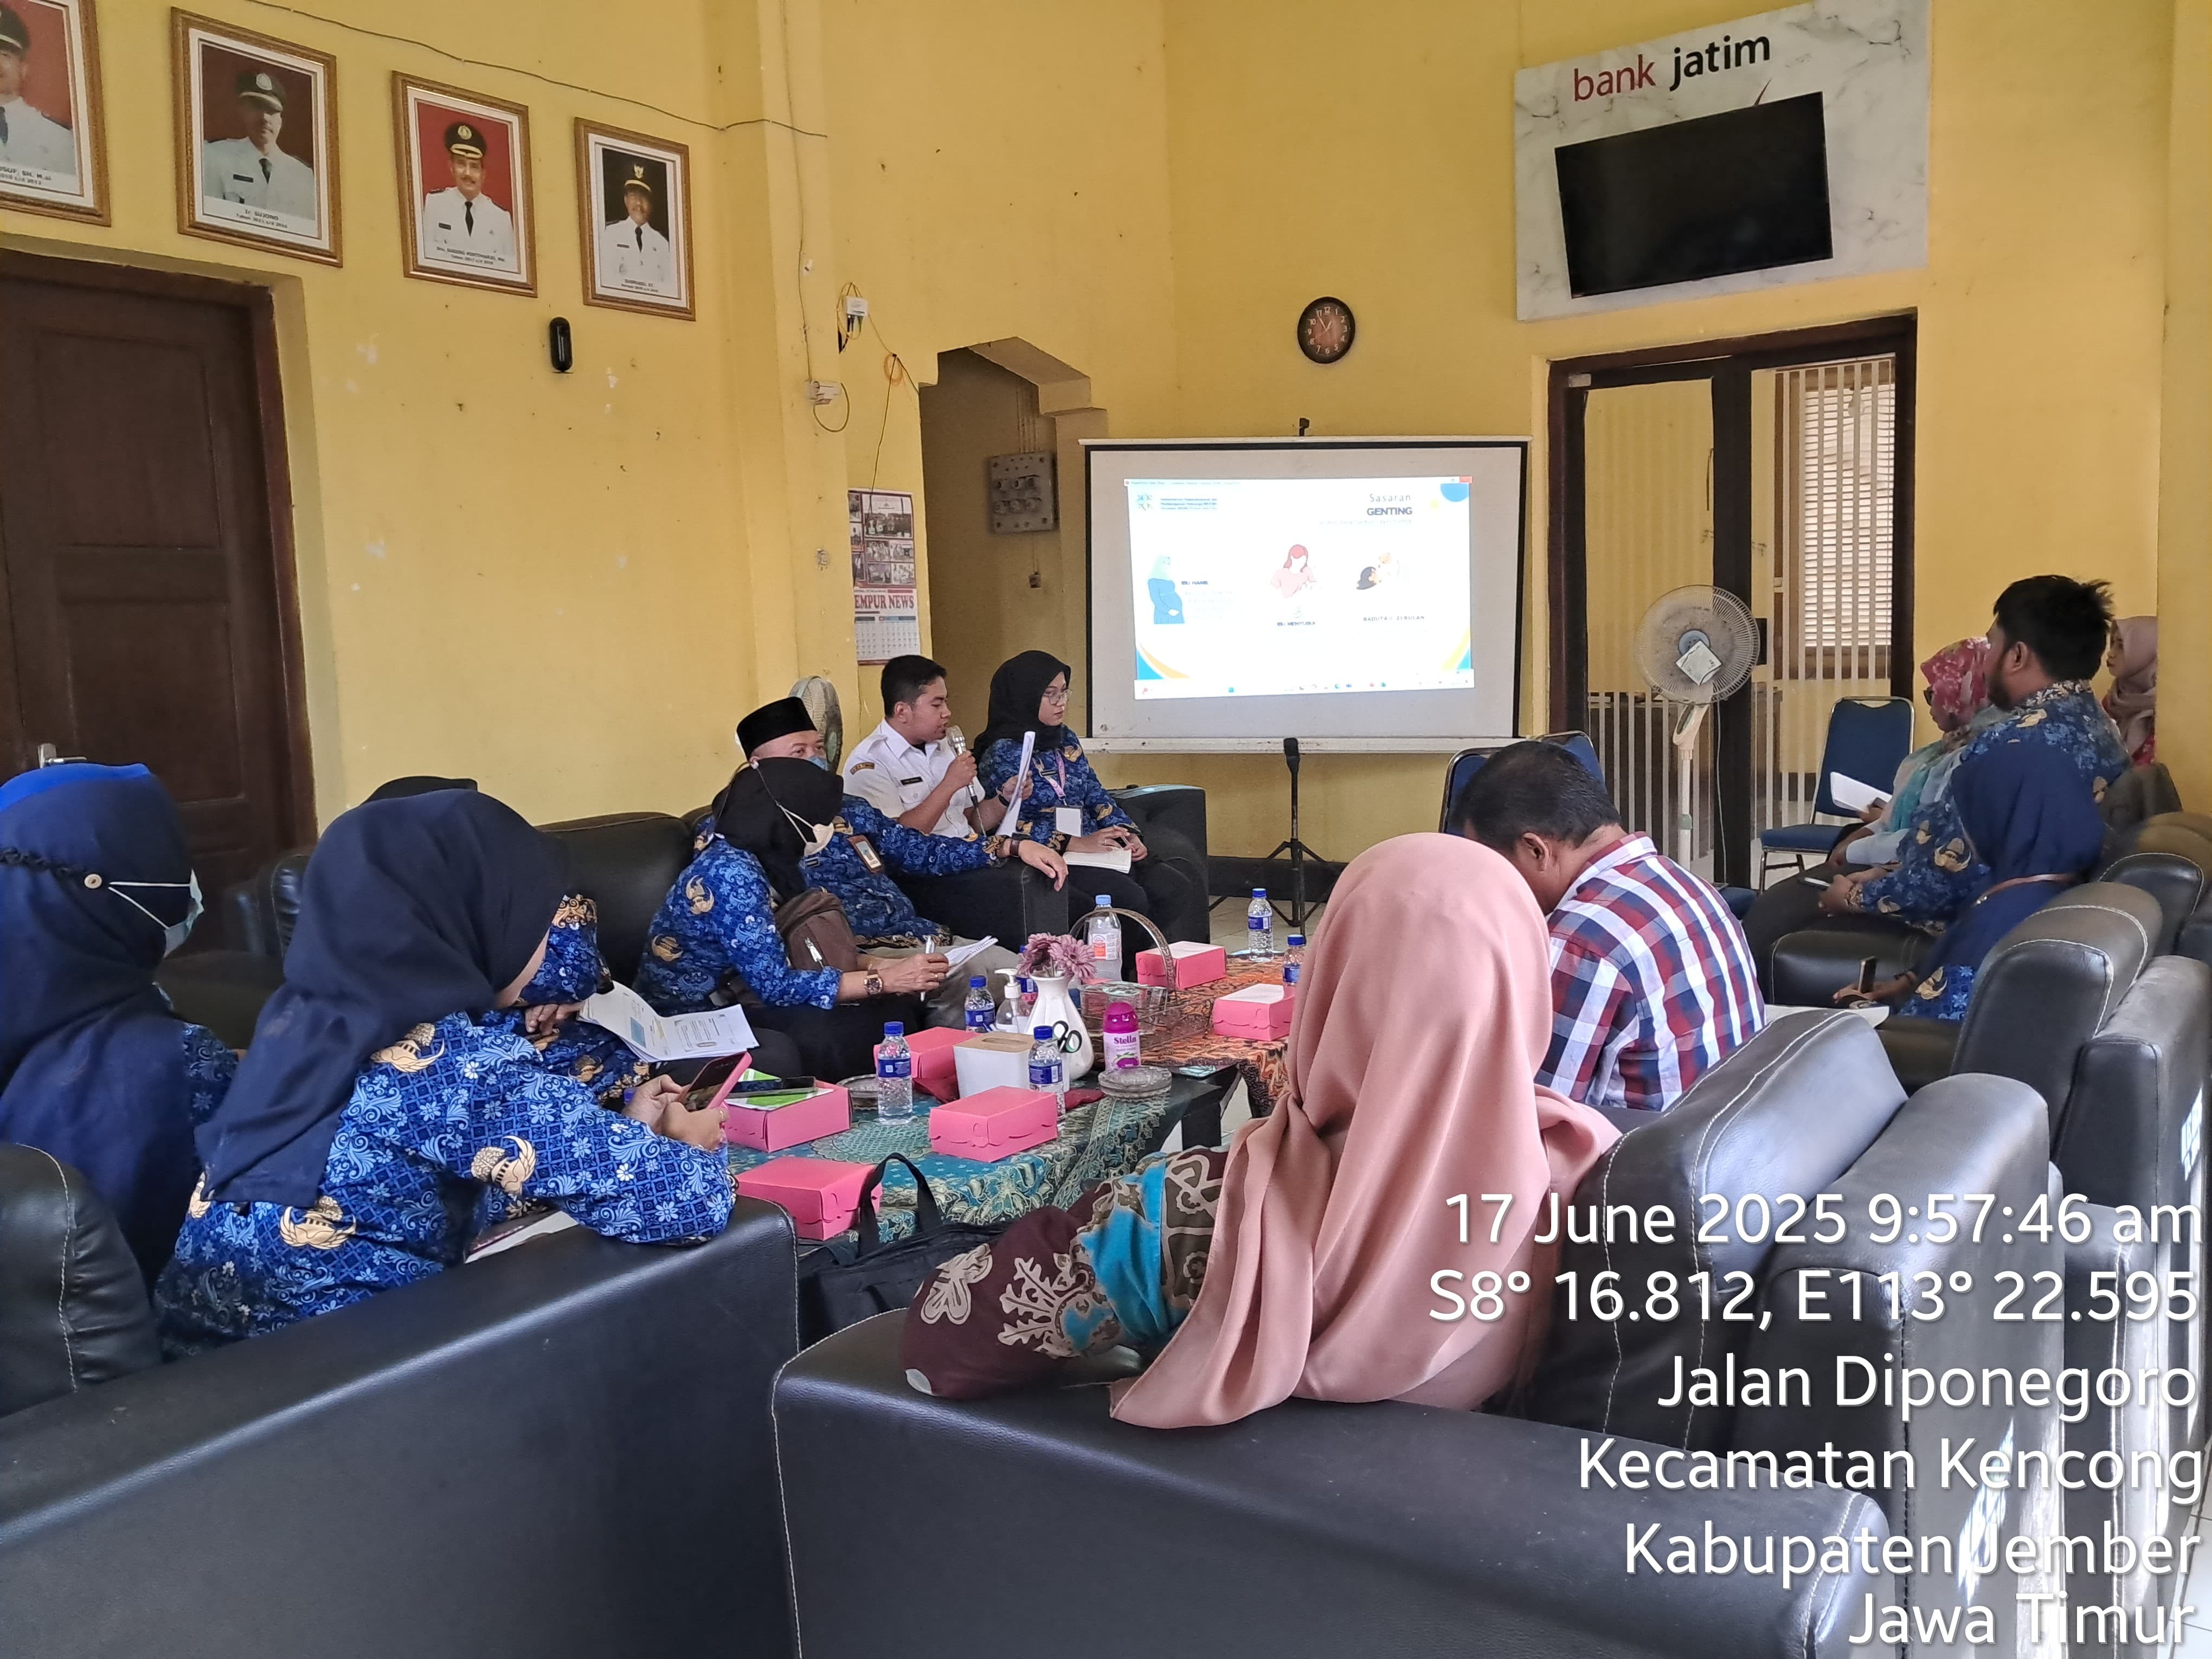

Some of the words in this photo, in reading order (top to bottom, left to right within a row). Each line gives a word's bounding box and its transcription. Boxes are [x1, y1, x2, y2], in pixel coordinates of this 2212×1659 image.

[1574, 54, 1656, 101] bank
[1669, 35, 1770, 92] jatim
[1316, 345, 1321, 354] 7
[1369, 493, 1411, 503] Sasaran
[1367, 507, 1413, 516] GENTING
[888, 595, 914, 609] NEWS
[1114, 1035, 1137, 1044] Stella
